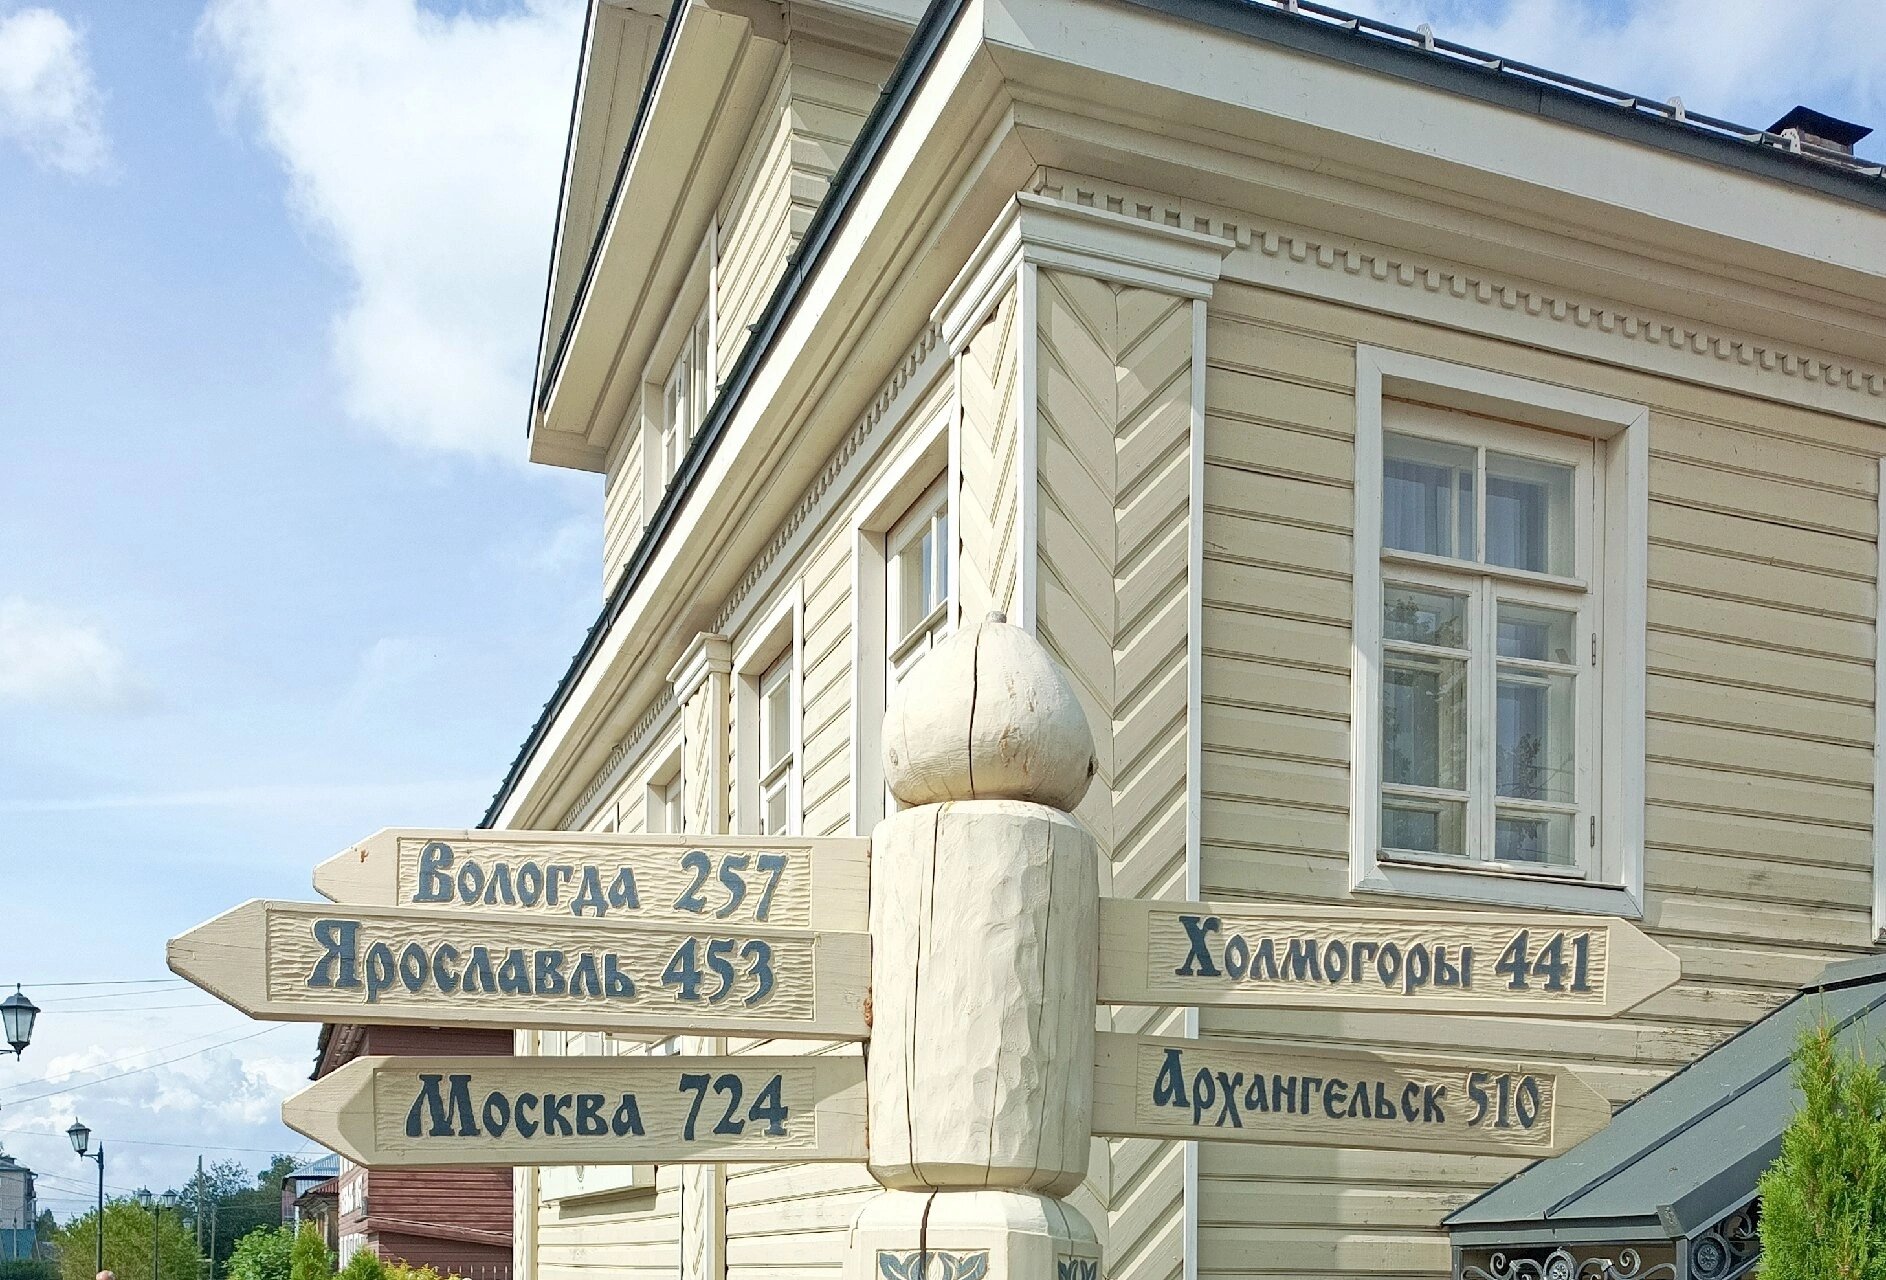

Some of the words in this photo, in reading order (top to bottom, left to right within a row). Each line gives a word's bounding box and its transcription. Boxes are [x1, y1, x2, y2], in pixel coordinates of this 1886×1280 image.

[412, 840, 640, 917] Вологда
[674, 850, 788, 921] 257
[307, 919, 636, 1003] Ярославль
[661, 938, 773, 1006] 453
[1175, 915, 1472, 993] Холмогоры
[1496, 929, 1591, 991] 441
[406, 1074, 643, 1138] Москва
[679, 1073, 788, 1141] 724
[1152, 1048, 1447, 1128] Архангельск
[1467, 1072, 1540, 1128] 510
